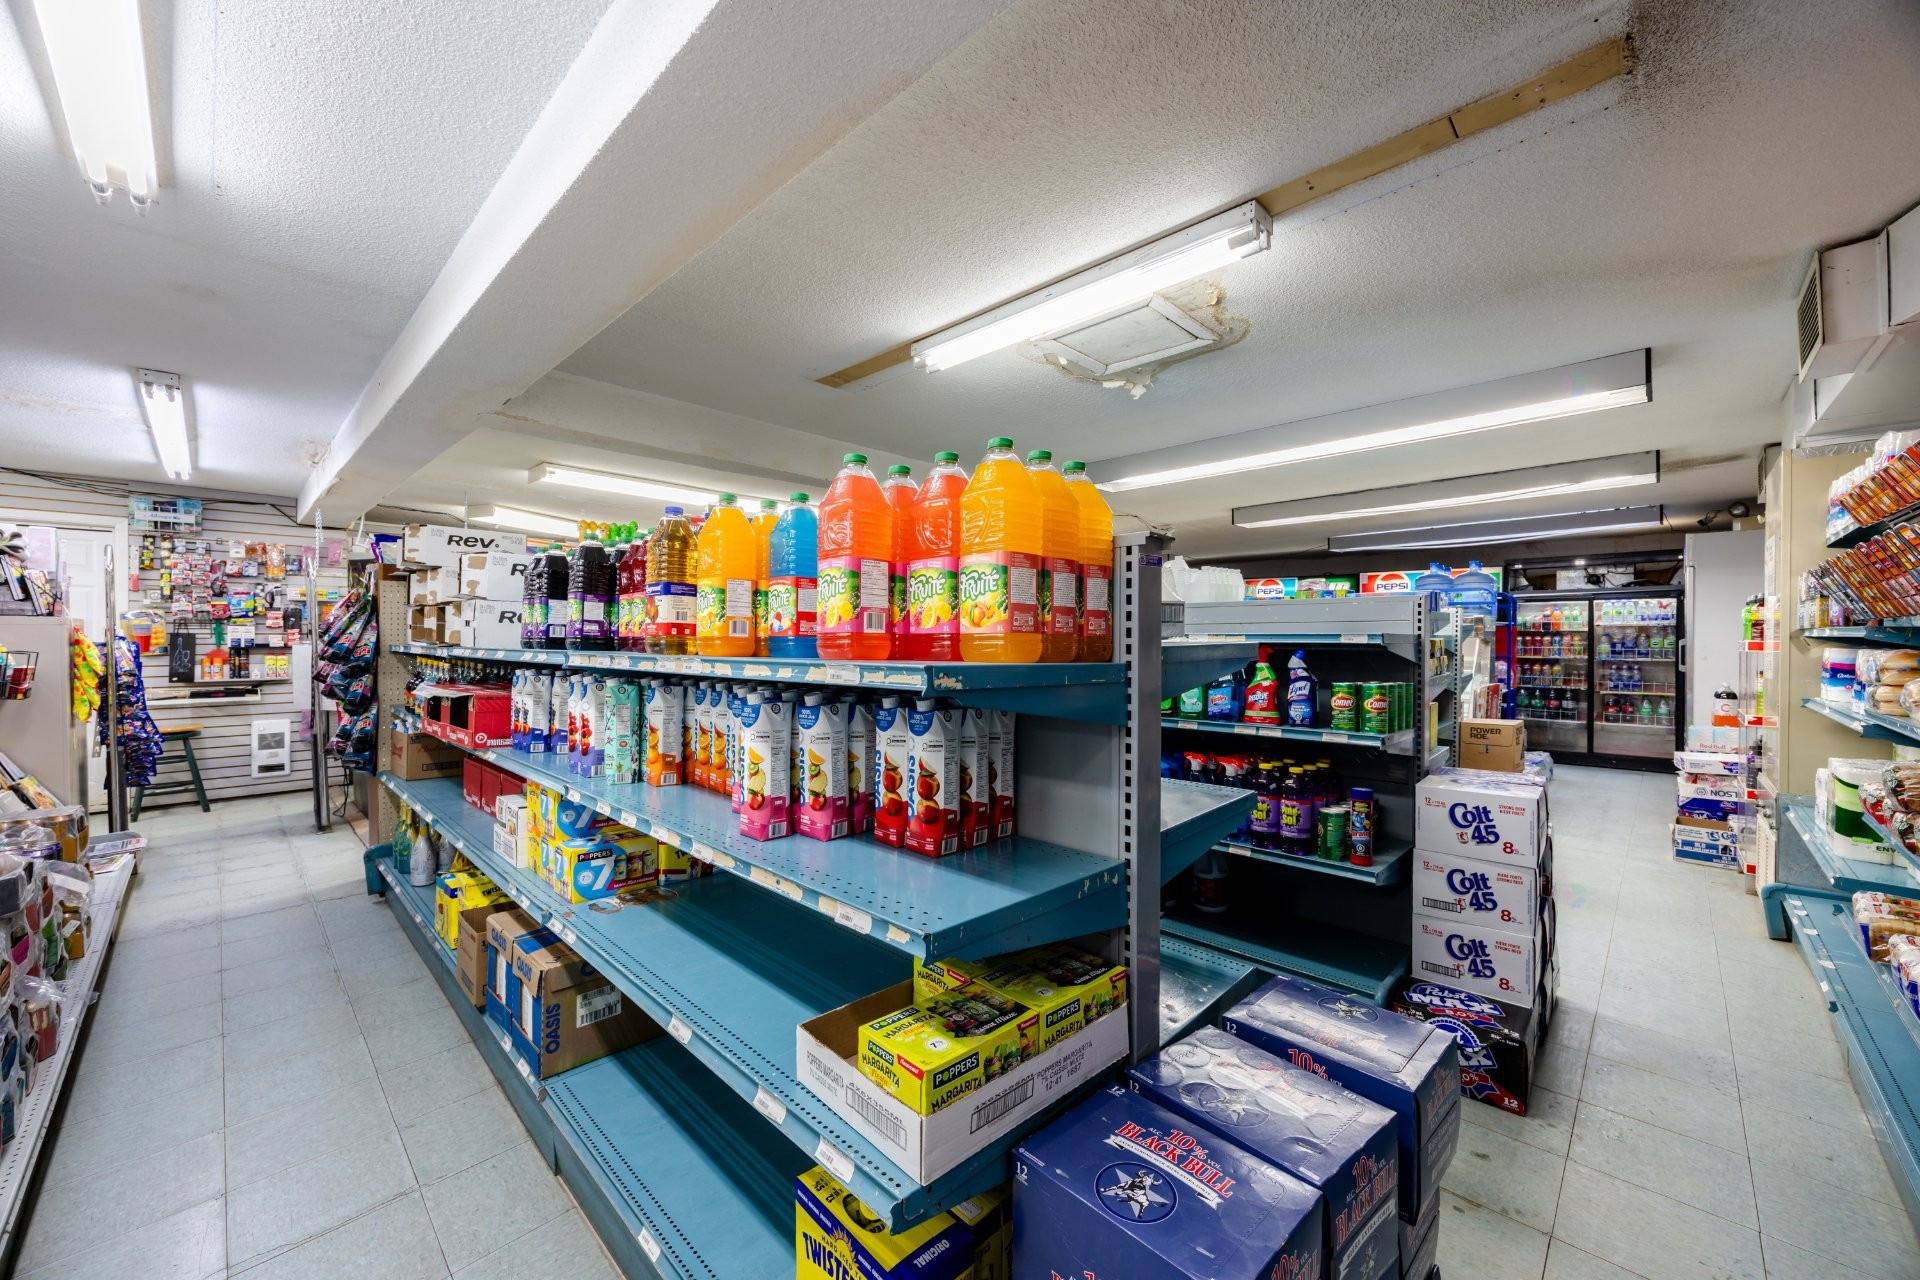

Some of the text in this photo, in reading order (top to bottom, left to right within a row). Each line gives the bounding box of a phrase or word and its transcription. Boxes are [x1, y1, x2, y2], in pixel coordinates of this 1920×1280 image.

[1376, 582, 1409, 591] PEPSI
[1332, 698, 1353, 707] Comet
[1470, 727, 1501, 735] POWER
[908, 755, 916, 820] OASIS
[1449, 802, 1494, 828] Colt
[1471, 824, 1500, 845] 45
[590, 855, 617, 891] 7
[1447, 868, 1492, 895] Colt
[1469, 892, 1498, 911] 45
[491, 928, 507, 952] OASIS
[1445, 934, 1490, 961] Colt
[517, 956, 533, 982] OASIS
[1467, 959, 1496, 978] 45
[1409, 993, 1500, 1015] MAX
[1421, 985, 1469, 1000] Pabst
[872, 1008, 920, 1031] POPPERS
[1047, 1003, 1079, 1026] POPPERS
[545, 1003, 561, 1055] OASIS
[883, 1014, 937, 1040] MARGARITA
[1044, 1020, 1083, 1048] MARGARITA
[869, 1043, 893, 1064] POPPERS
[1062, 1040, 1093, 1064] MARGARITA
[862, 1053, 900, 1088] MARGARITA
[935, 1058, 978, 1086] POPPERS
[931, 1077, 983, 1113] MARGARITA
[1130, 1080, 1139, 1094] 12
[1016, 1162, 1028, 1179] 12
[1115, 1121, 1236, 1199] BLACK BULL
[1336, 1159, 1397, 1250] BLACK BULL
[821, 1235, 838, 1252] HARD
[913, 1239, 950, 1269] ORIGINAL
